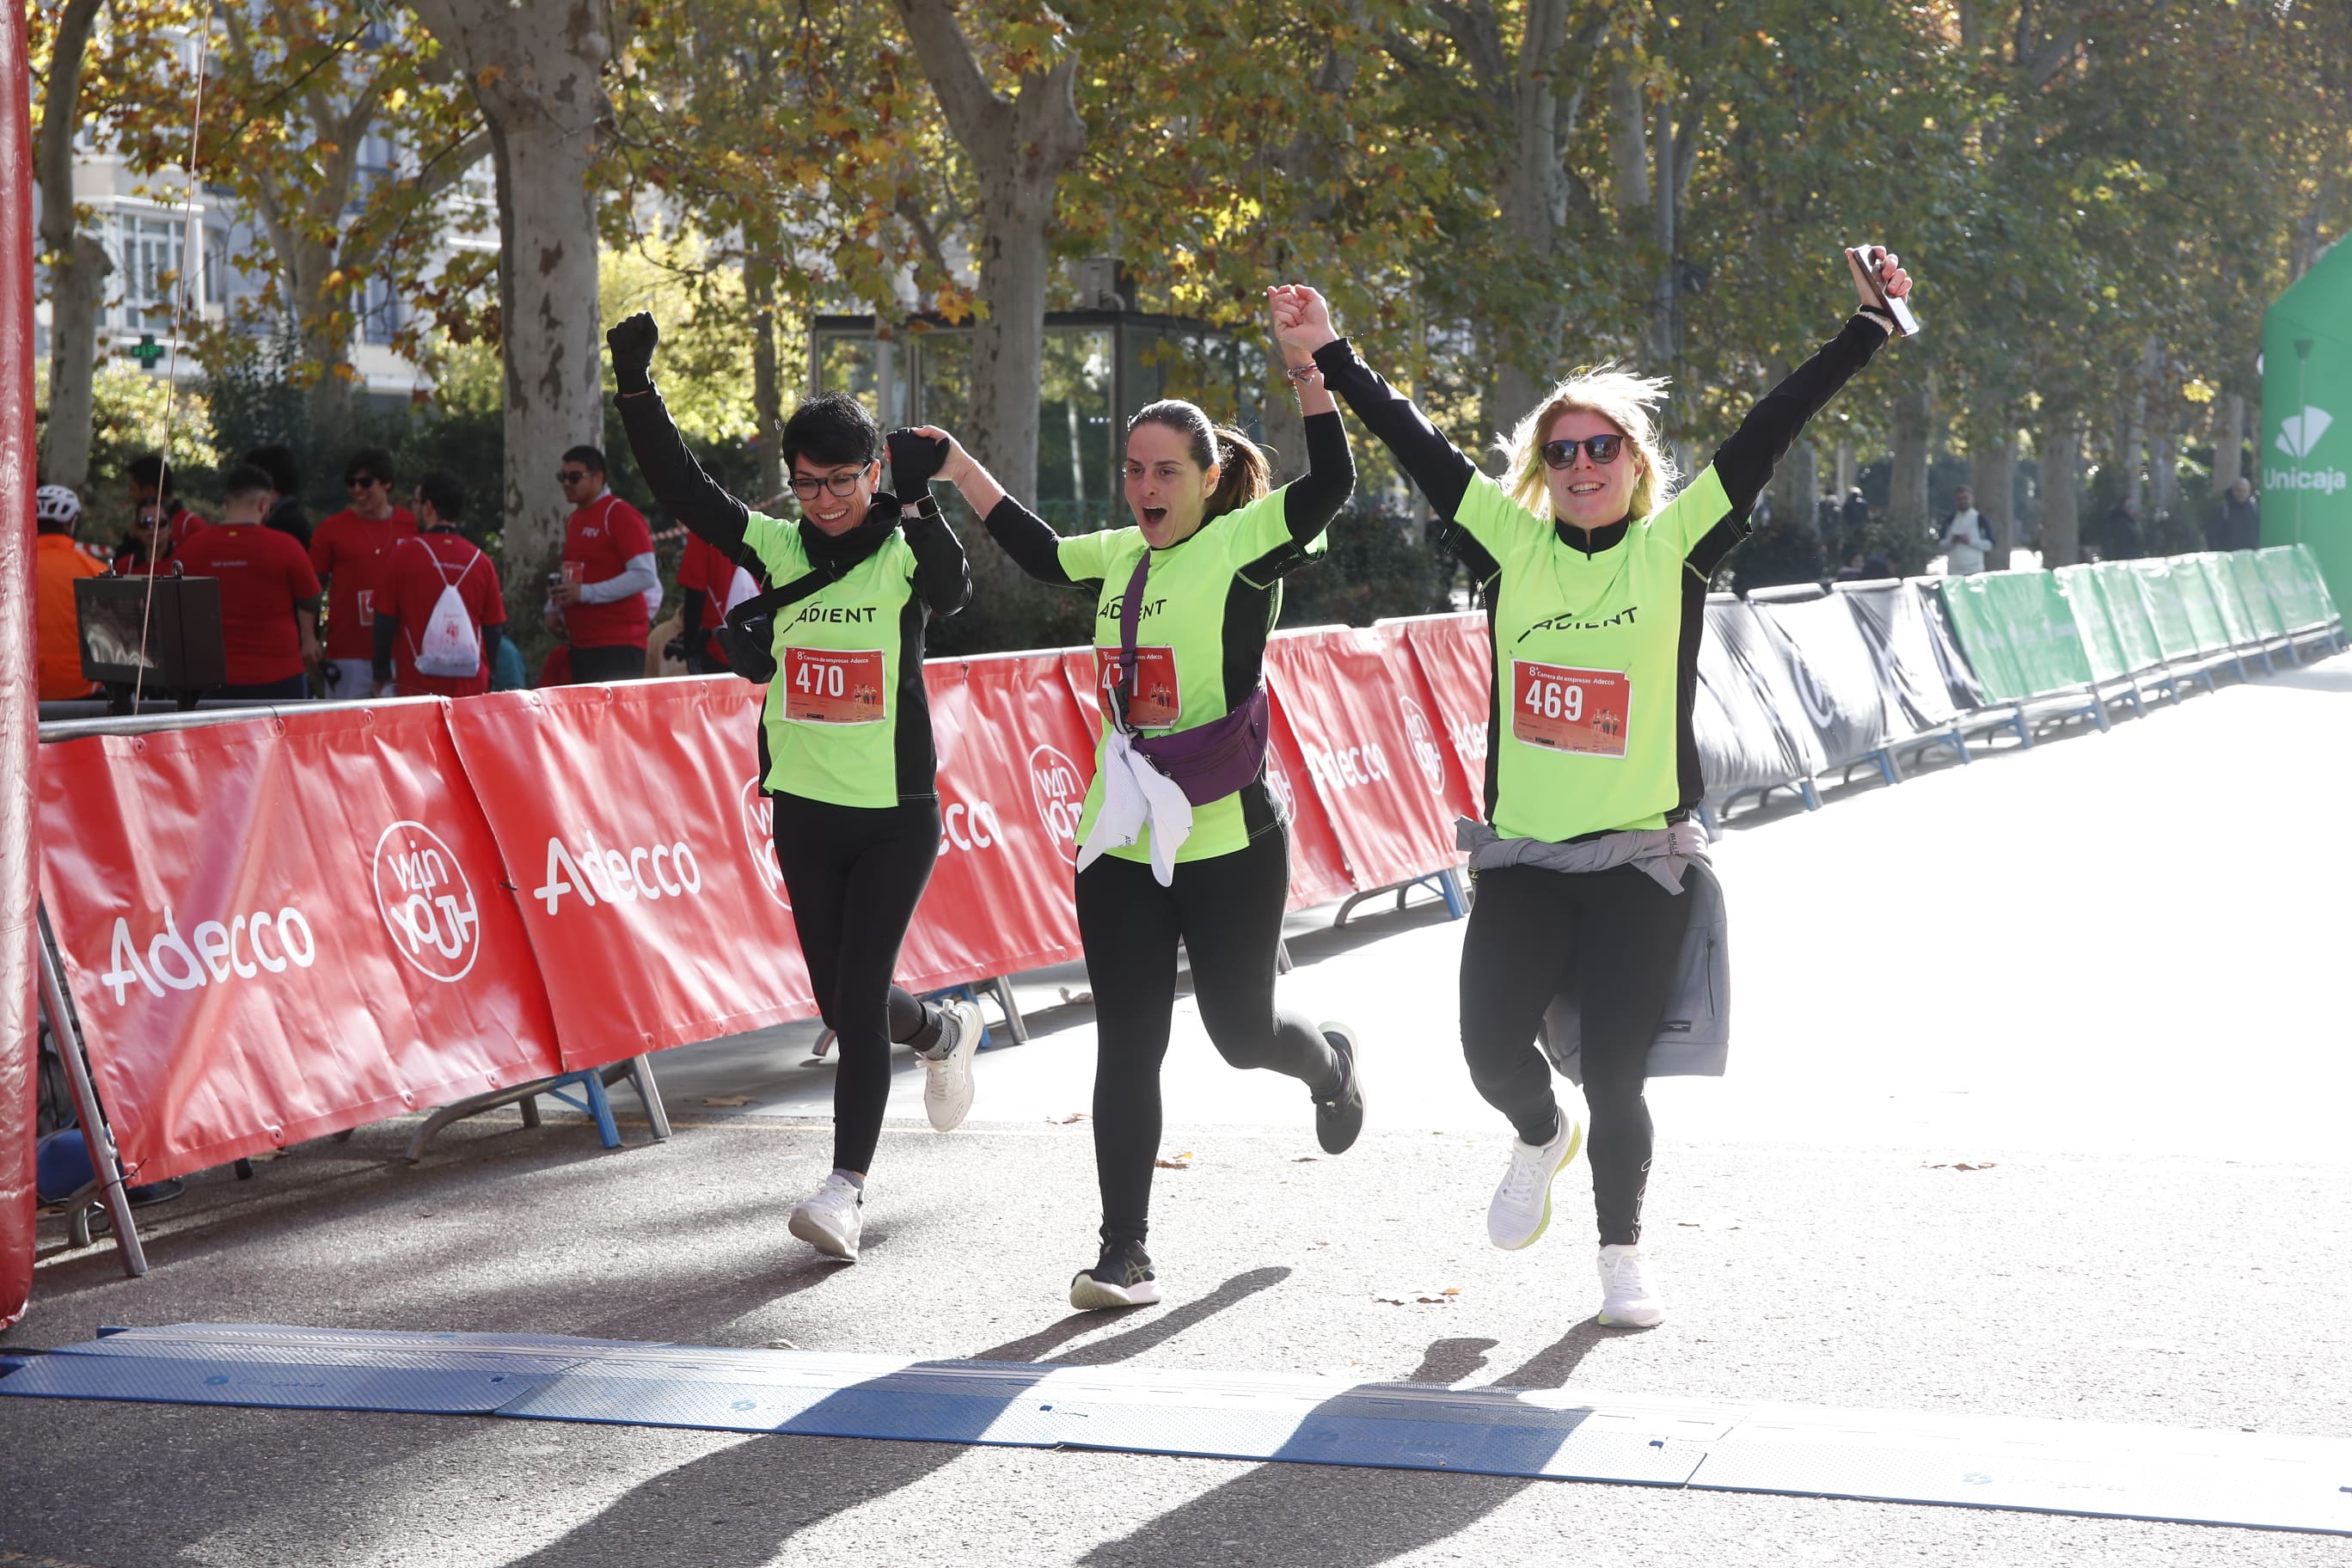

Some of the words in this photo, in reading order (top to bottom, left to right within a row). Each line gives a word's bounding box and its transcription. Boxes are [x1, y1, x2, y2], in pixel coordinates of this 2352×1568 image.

[2263, 467, 2347, 496] Unicaja
[795, 607, 877, 623] ADIENT
[795, 662, 844, 697] 470
[1537, 671, 1556, 680] Carrera
[1525, 679, 1583, 721] 469
[1035, 759, 1076, 805] win
[1304, 737, 1390, 794] Adecco
[388, 840, 450, 900] win
[533, 829, 701, 916] Adecco
[390, 891, 477, 959] YOUTH
[101, 905, 315, 1007] Adecco
